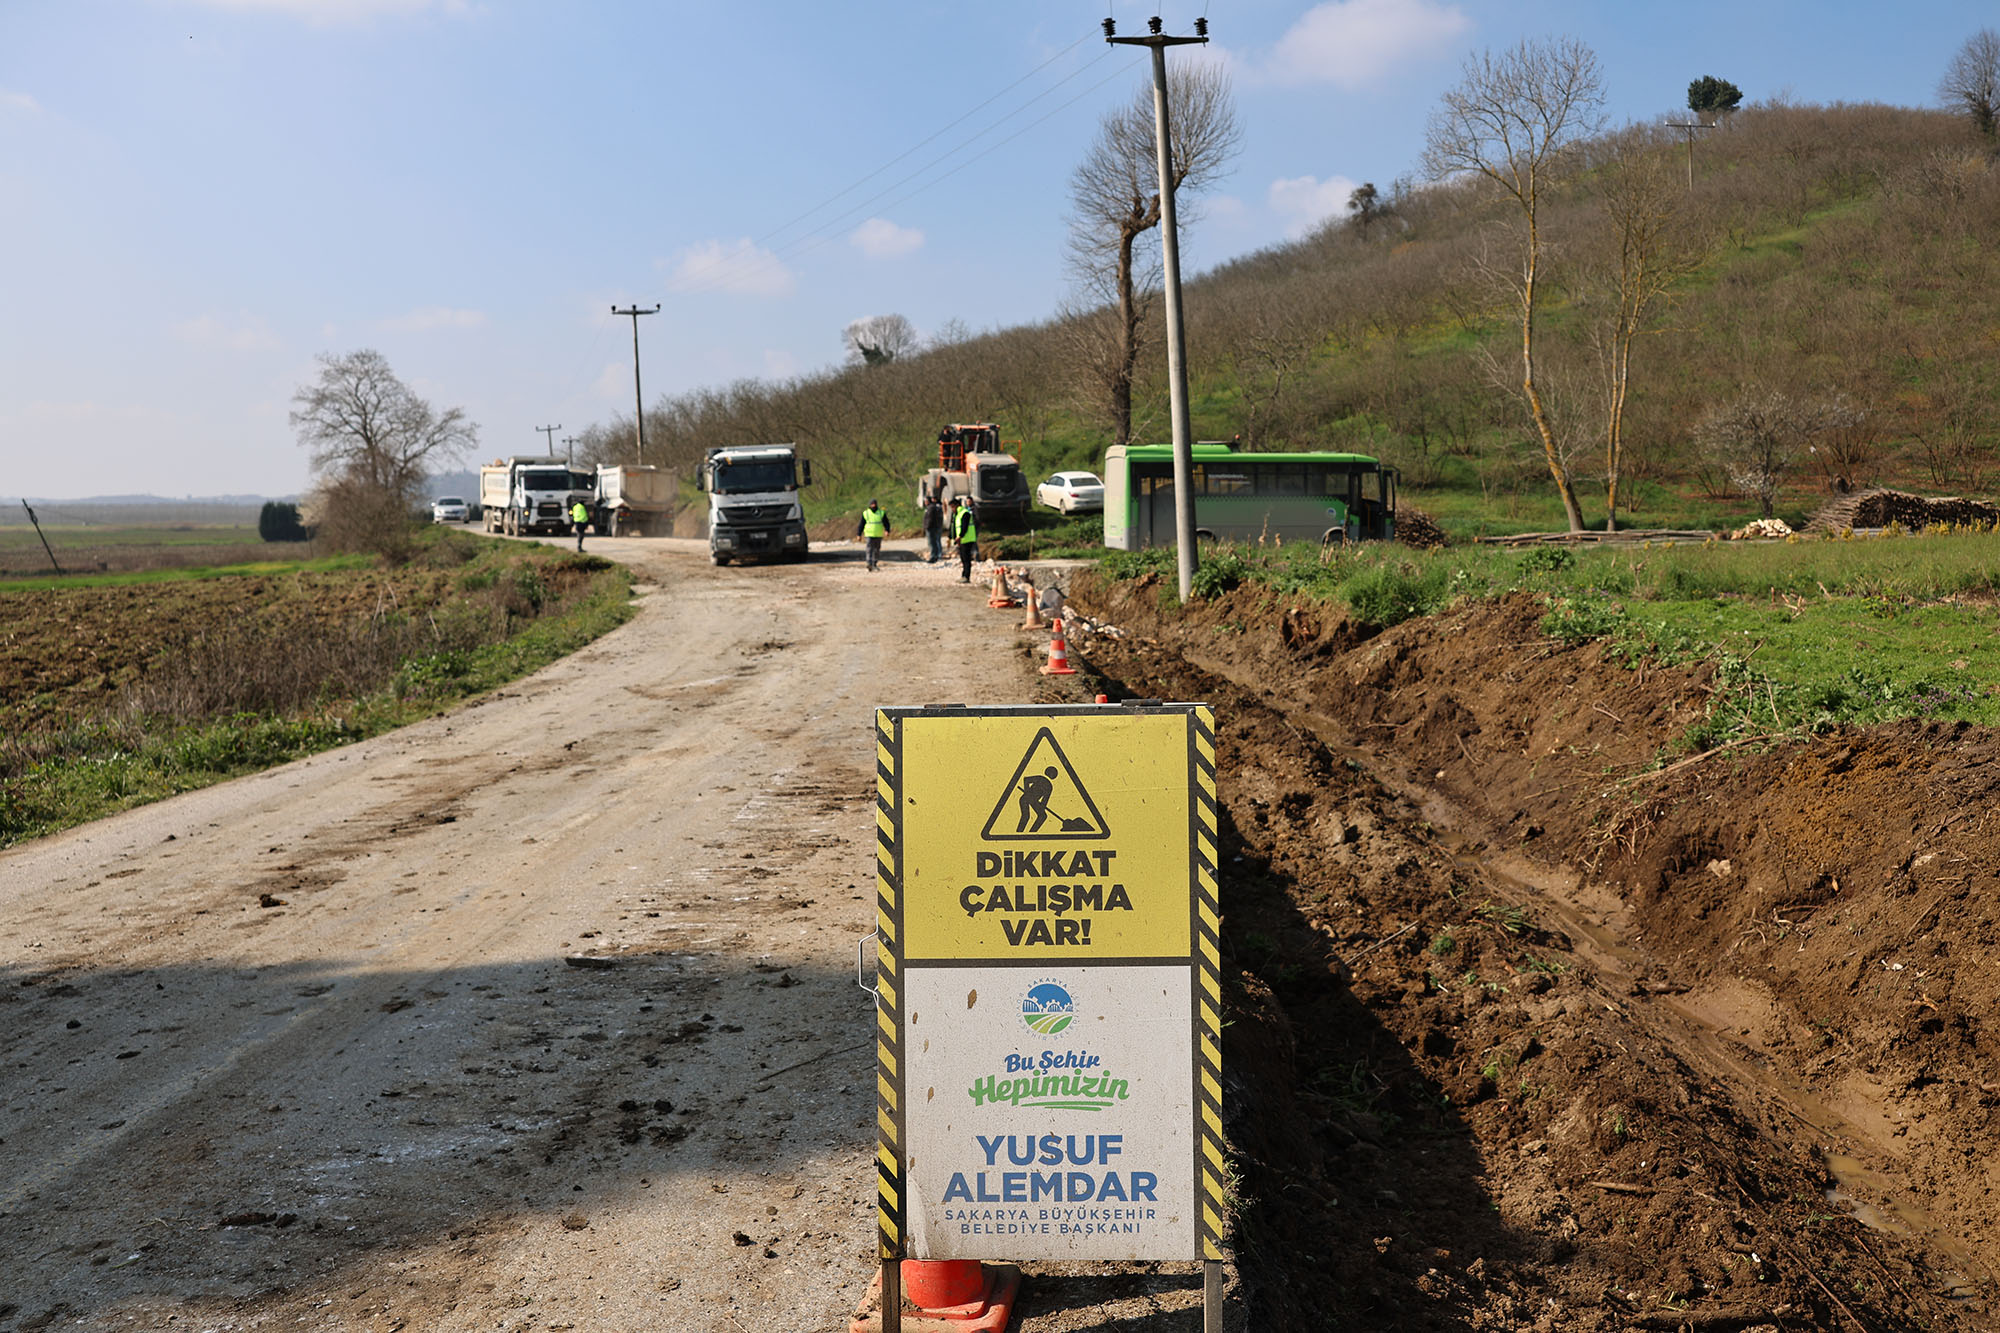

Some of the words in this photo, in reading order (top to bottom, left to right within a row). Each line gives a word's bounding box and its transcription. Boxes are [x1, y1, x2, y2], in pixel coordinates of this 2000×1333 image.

[976, 850, 1117, 878] DİKKAT
[959, 884, 1134, 917] ÇALIŞMA
[999, 918, 1092, 946] VAR!
[1027, 977, 1068, 989] SAKARYA
[1004, 1052, 1035, 1074] Bu
[1039, 1050, 1101, 1075] Şehir
[968, 1069, 1130, 1107] Hepimizin
[976, 1134, 1124, 1166] YUSUF
[942, 1171, 1159, 1203] ALEMDAR
[945, 1208, 1029, 1221] SAKARYA
[1039, 1206, 1156, 1222] BÜYÜKŞEHİR
[960, 1221, 1050, 1235] BELEDİYE
[1059, 1223, 1141, 1236] BAŞKANI
